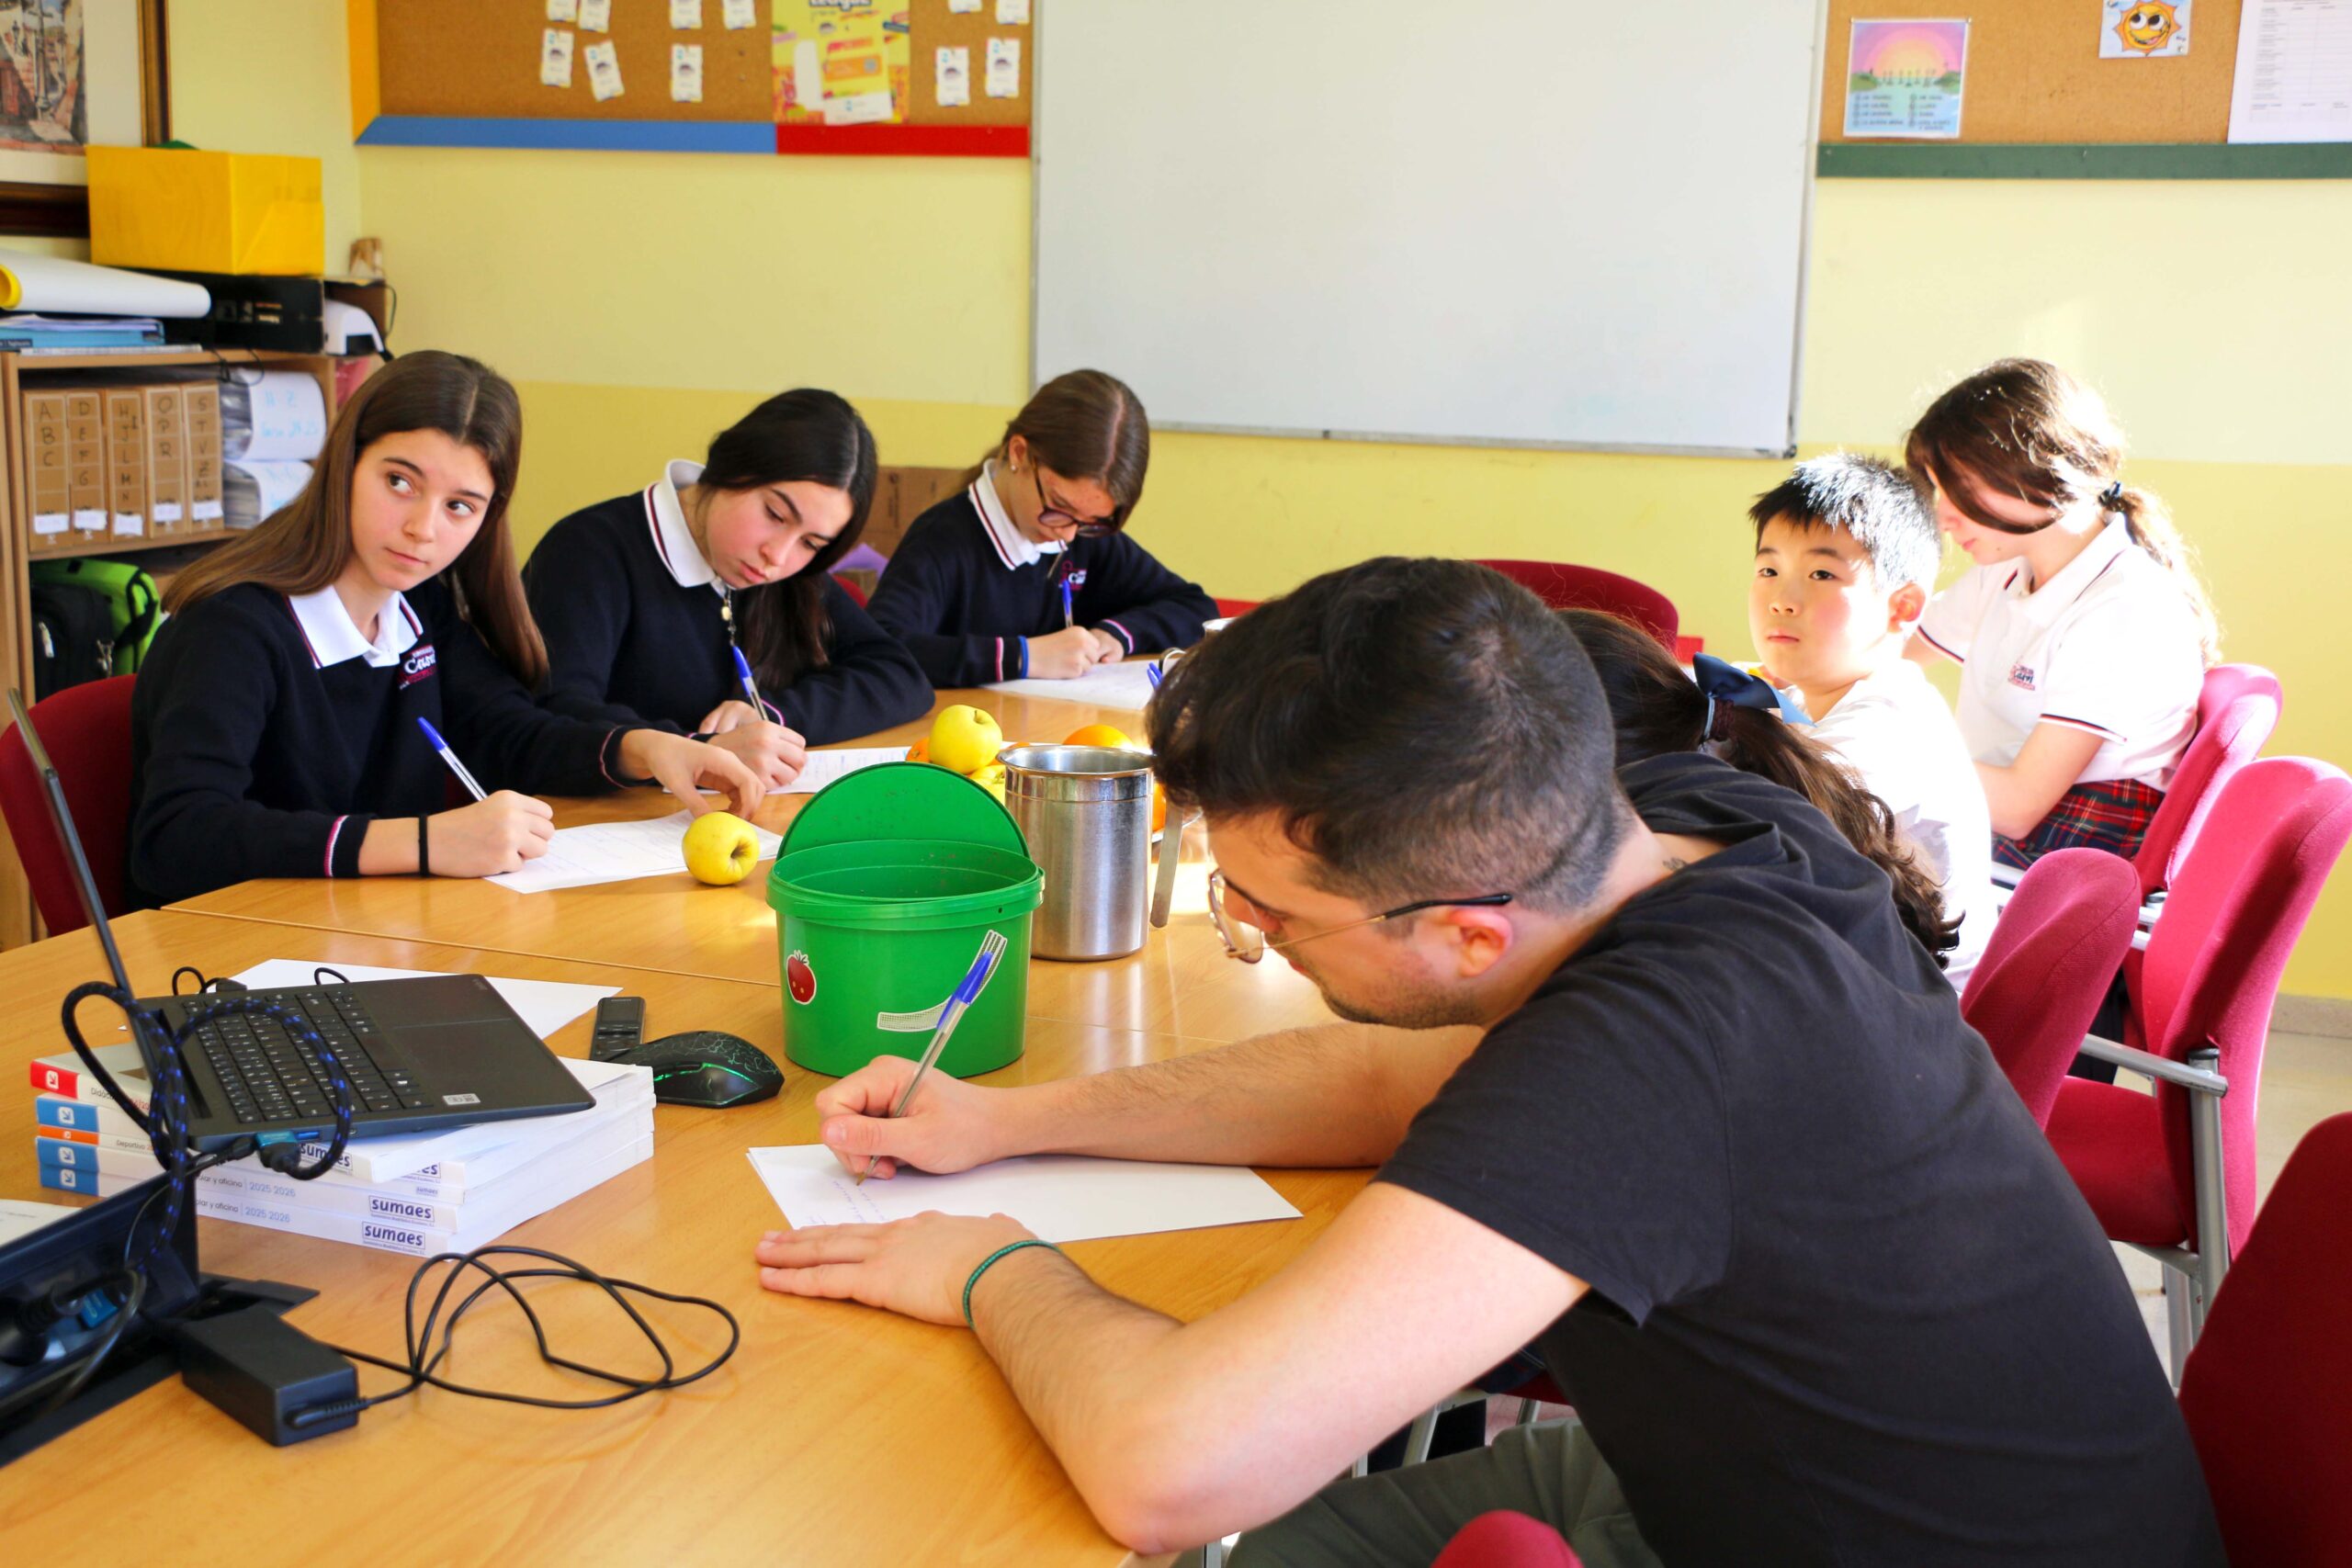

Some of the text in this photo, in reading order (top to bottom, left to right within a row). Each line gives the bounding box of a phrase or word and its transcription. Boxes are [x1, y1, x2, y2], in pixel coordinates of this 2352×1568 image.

[40, 401, 51, 420] A
[78, 401, 90, 416] D
[119, 404, 130, 416] H
[157, 396, 173, 412] O
[198, 397, 207, 411] S
[79, 427, 87, 441] E
[121, 425, 130, 442] J
[158, 420, 170, 434] P
[197, 421, 207, 434] T
[41, 427, 55, 445] B
[160, 442, 172, 457] R
[198, 441, 207, 455] V
[43, 451, 53, 467] C
[79, 450, 89, 463] F
[122, 450, 130, 464] L
[120, 473, 131, 485] M
[122, 492, 130, 502] N
[300, 1143, 351, 1168] sumes
[244, 1206, 267, 1219] 2025
[371, 1199, 432, 1219] sumaes
[364, 1225, 424, 1247] sumaes
